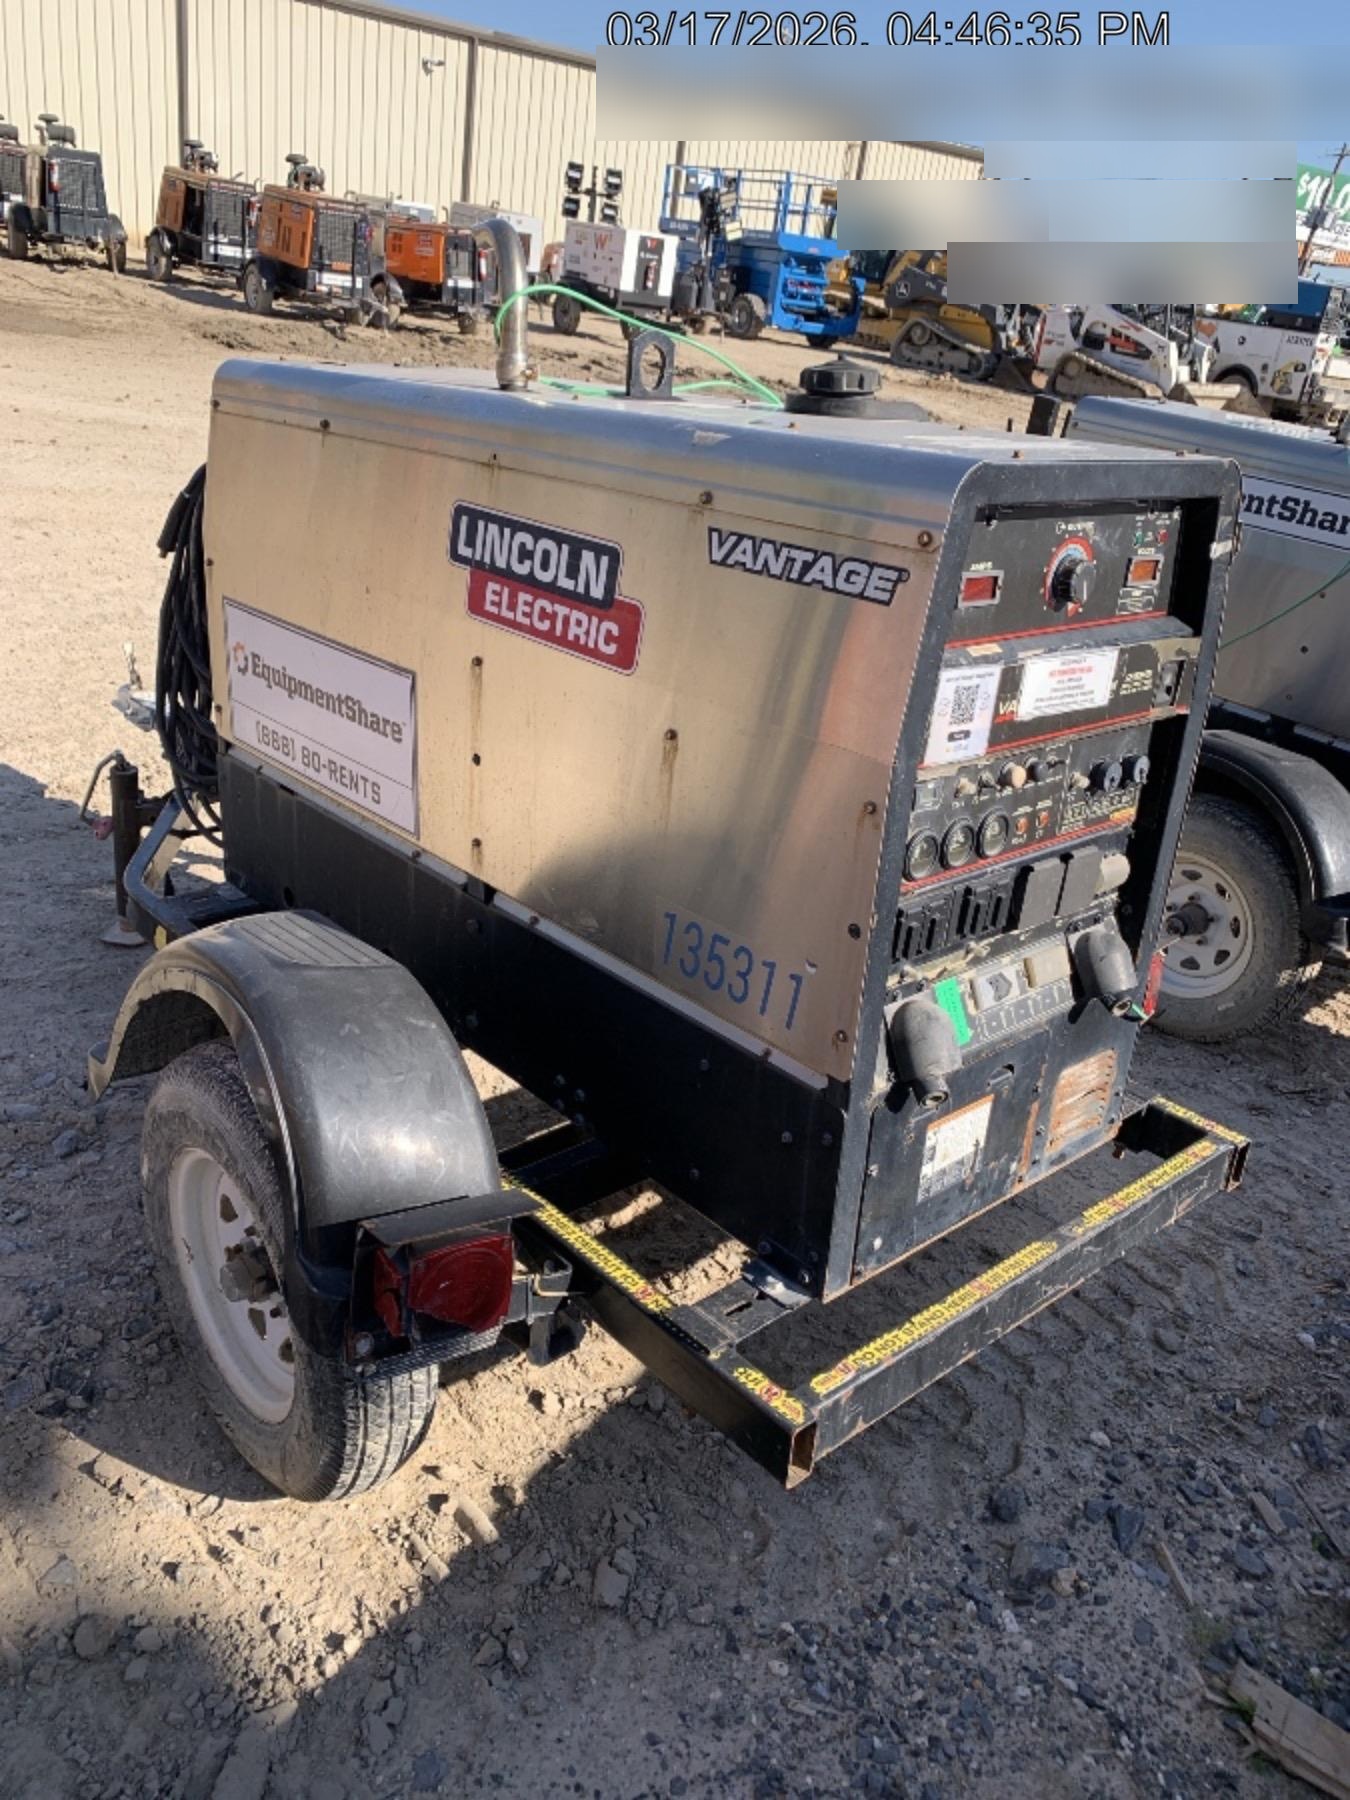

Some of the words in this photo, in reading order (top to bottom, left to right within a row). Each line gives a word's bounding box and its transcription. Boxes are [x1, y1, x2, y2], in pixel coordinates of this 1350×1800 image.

[1240, 493, 1350, 535] ntShar
[456, 514, 609, 601] LINCOLN
[708, 527, 902, 606] VANTAGE
[484, 581, 620, 655] ELECTRIC
[251, 651, 403, 743] EquipmentShare
[664, 911, 804, 1031] 135311
[878, 1333, 903, 1354] NOT
[902, 1308, 946, 1336] STAND
